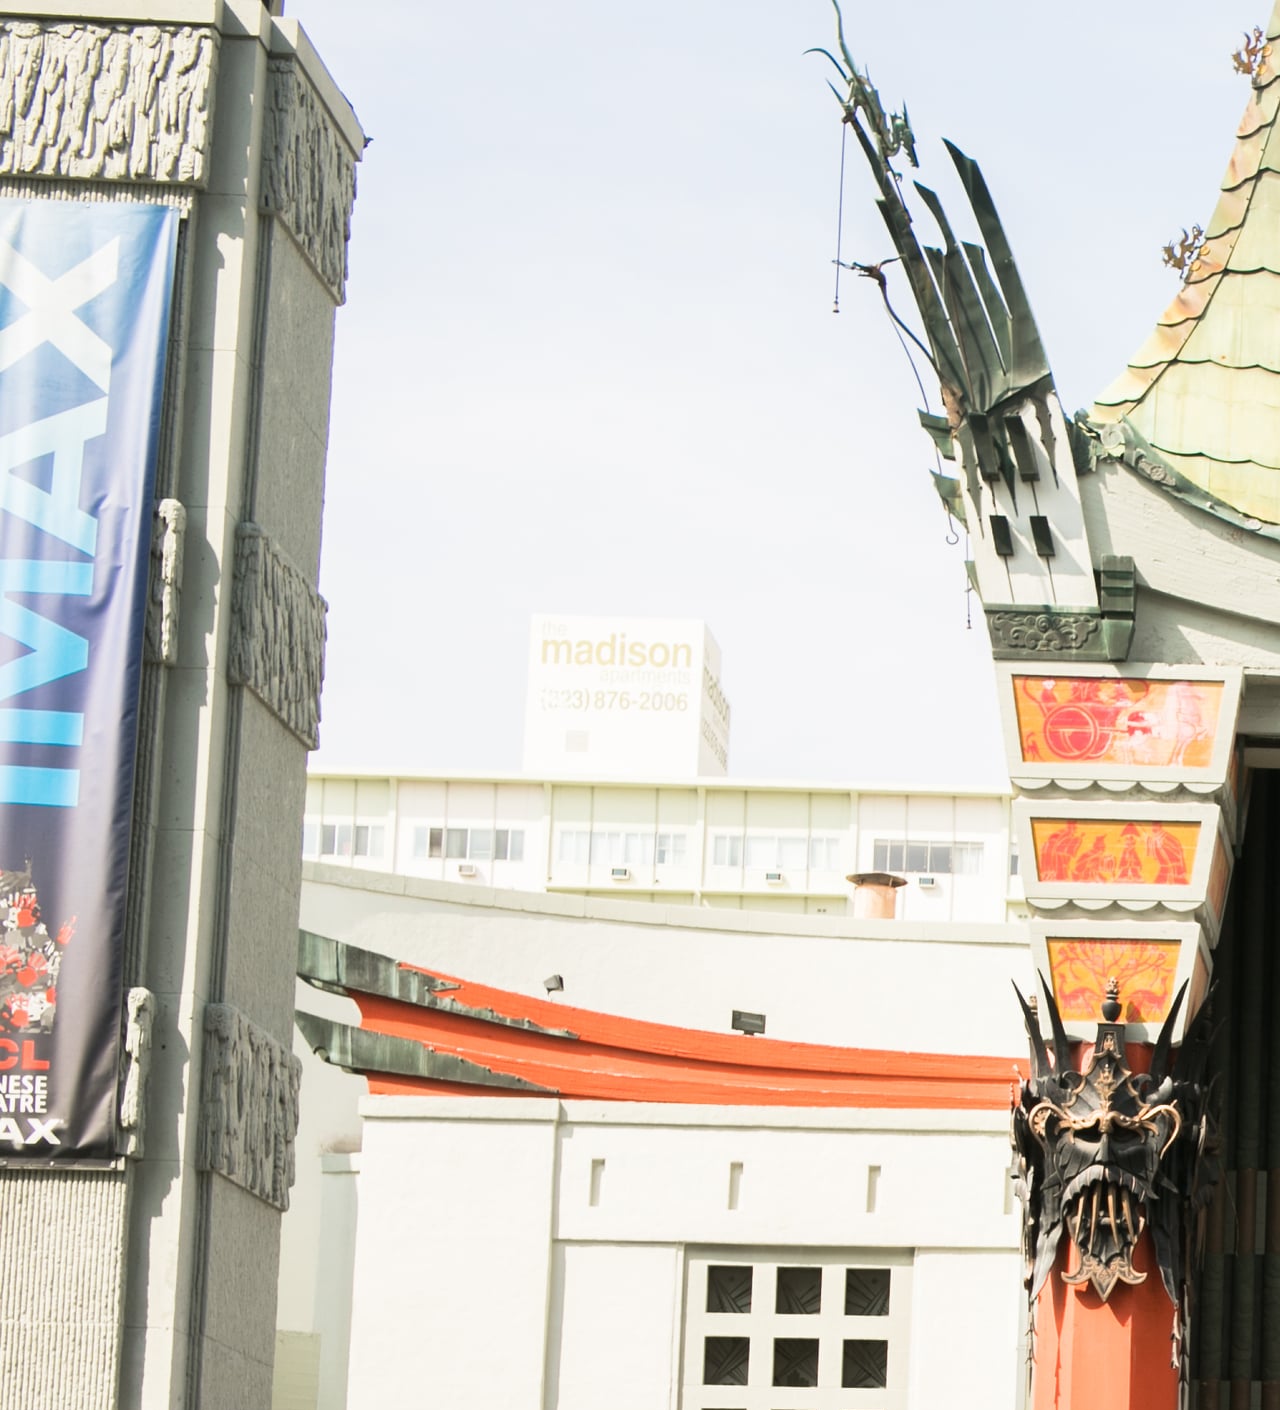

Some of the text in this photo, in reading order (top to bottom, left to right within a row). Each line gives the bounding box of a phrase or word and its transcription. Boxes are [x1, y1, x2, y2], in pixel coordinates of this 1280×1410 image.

[0, 235, 119, 807] IMAX
[541, 632, 693, 668] madison
[594, 690, 688, 712] 876-2006
